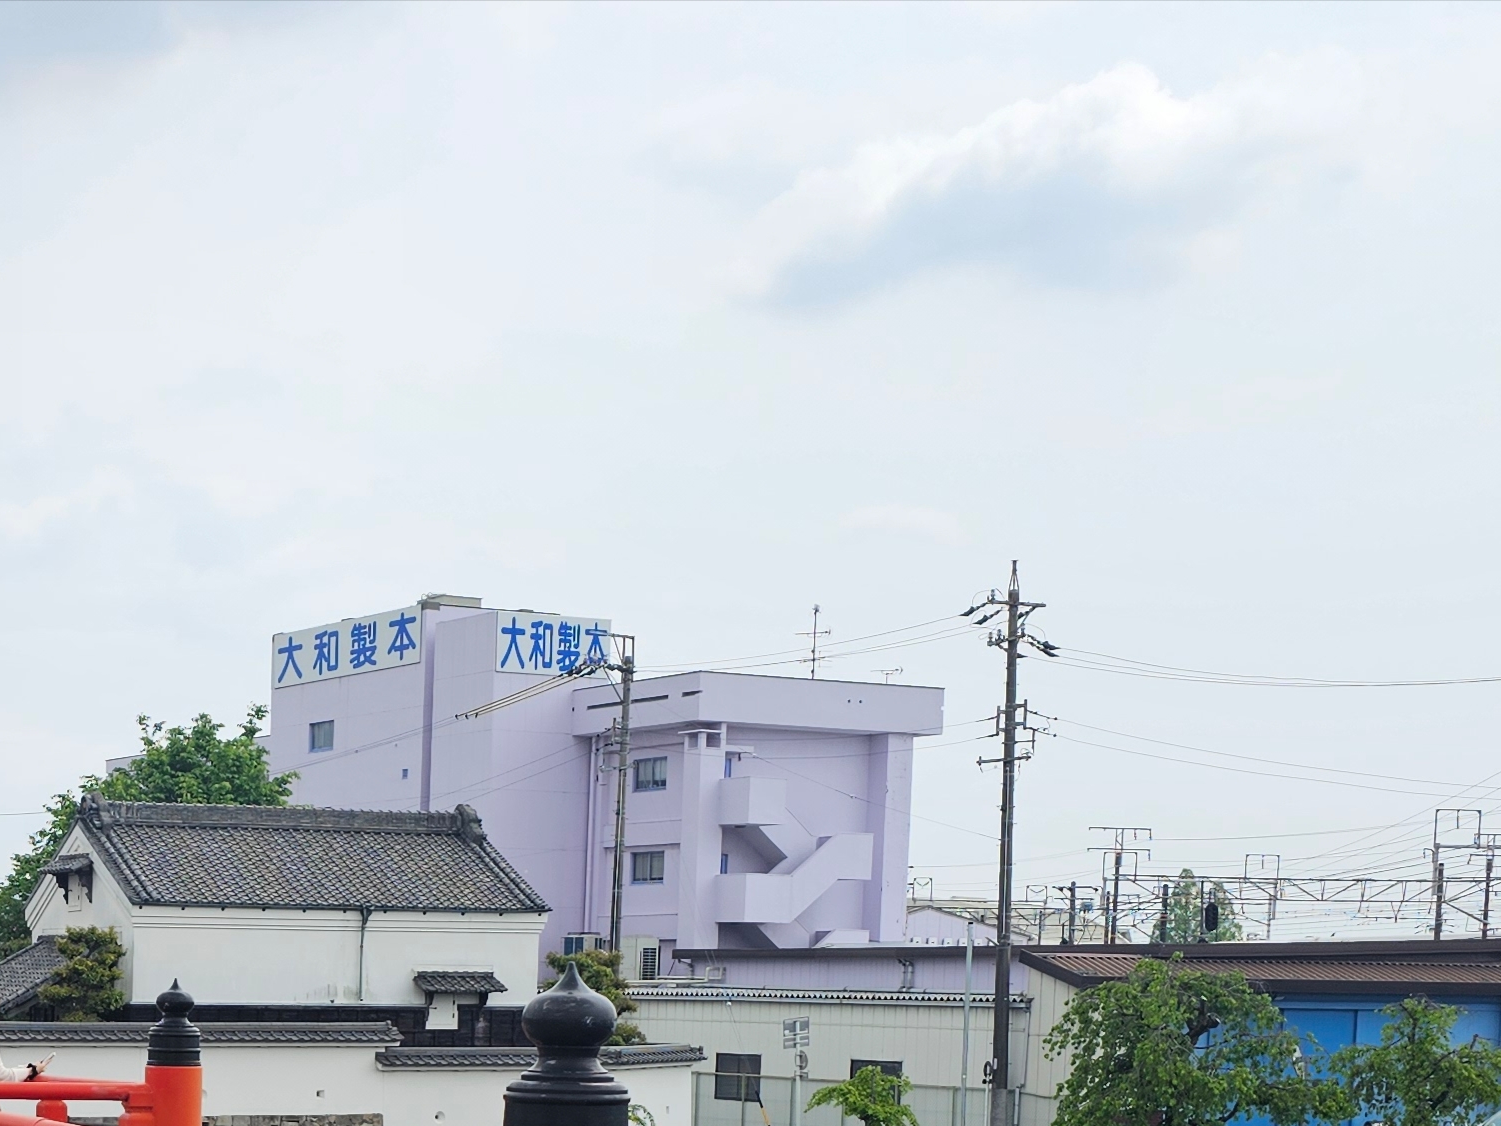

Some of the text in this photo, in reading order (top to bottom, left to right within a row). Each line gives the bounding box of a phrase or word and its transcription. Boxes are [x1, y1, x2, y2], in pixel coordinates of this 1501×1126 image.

[277, 612, 417, 684] 大和製本
[501, 616, 608, 671] 大和製本
